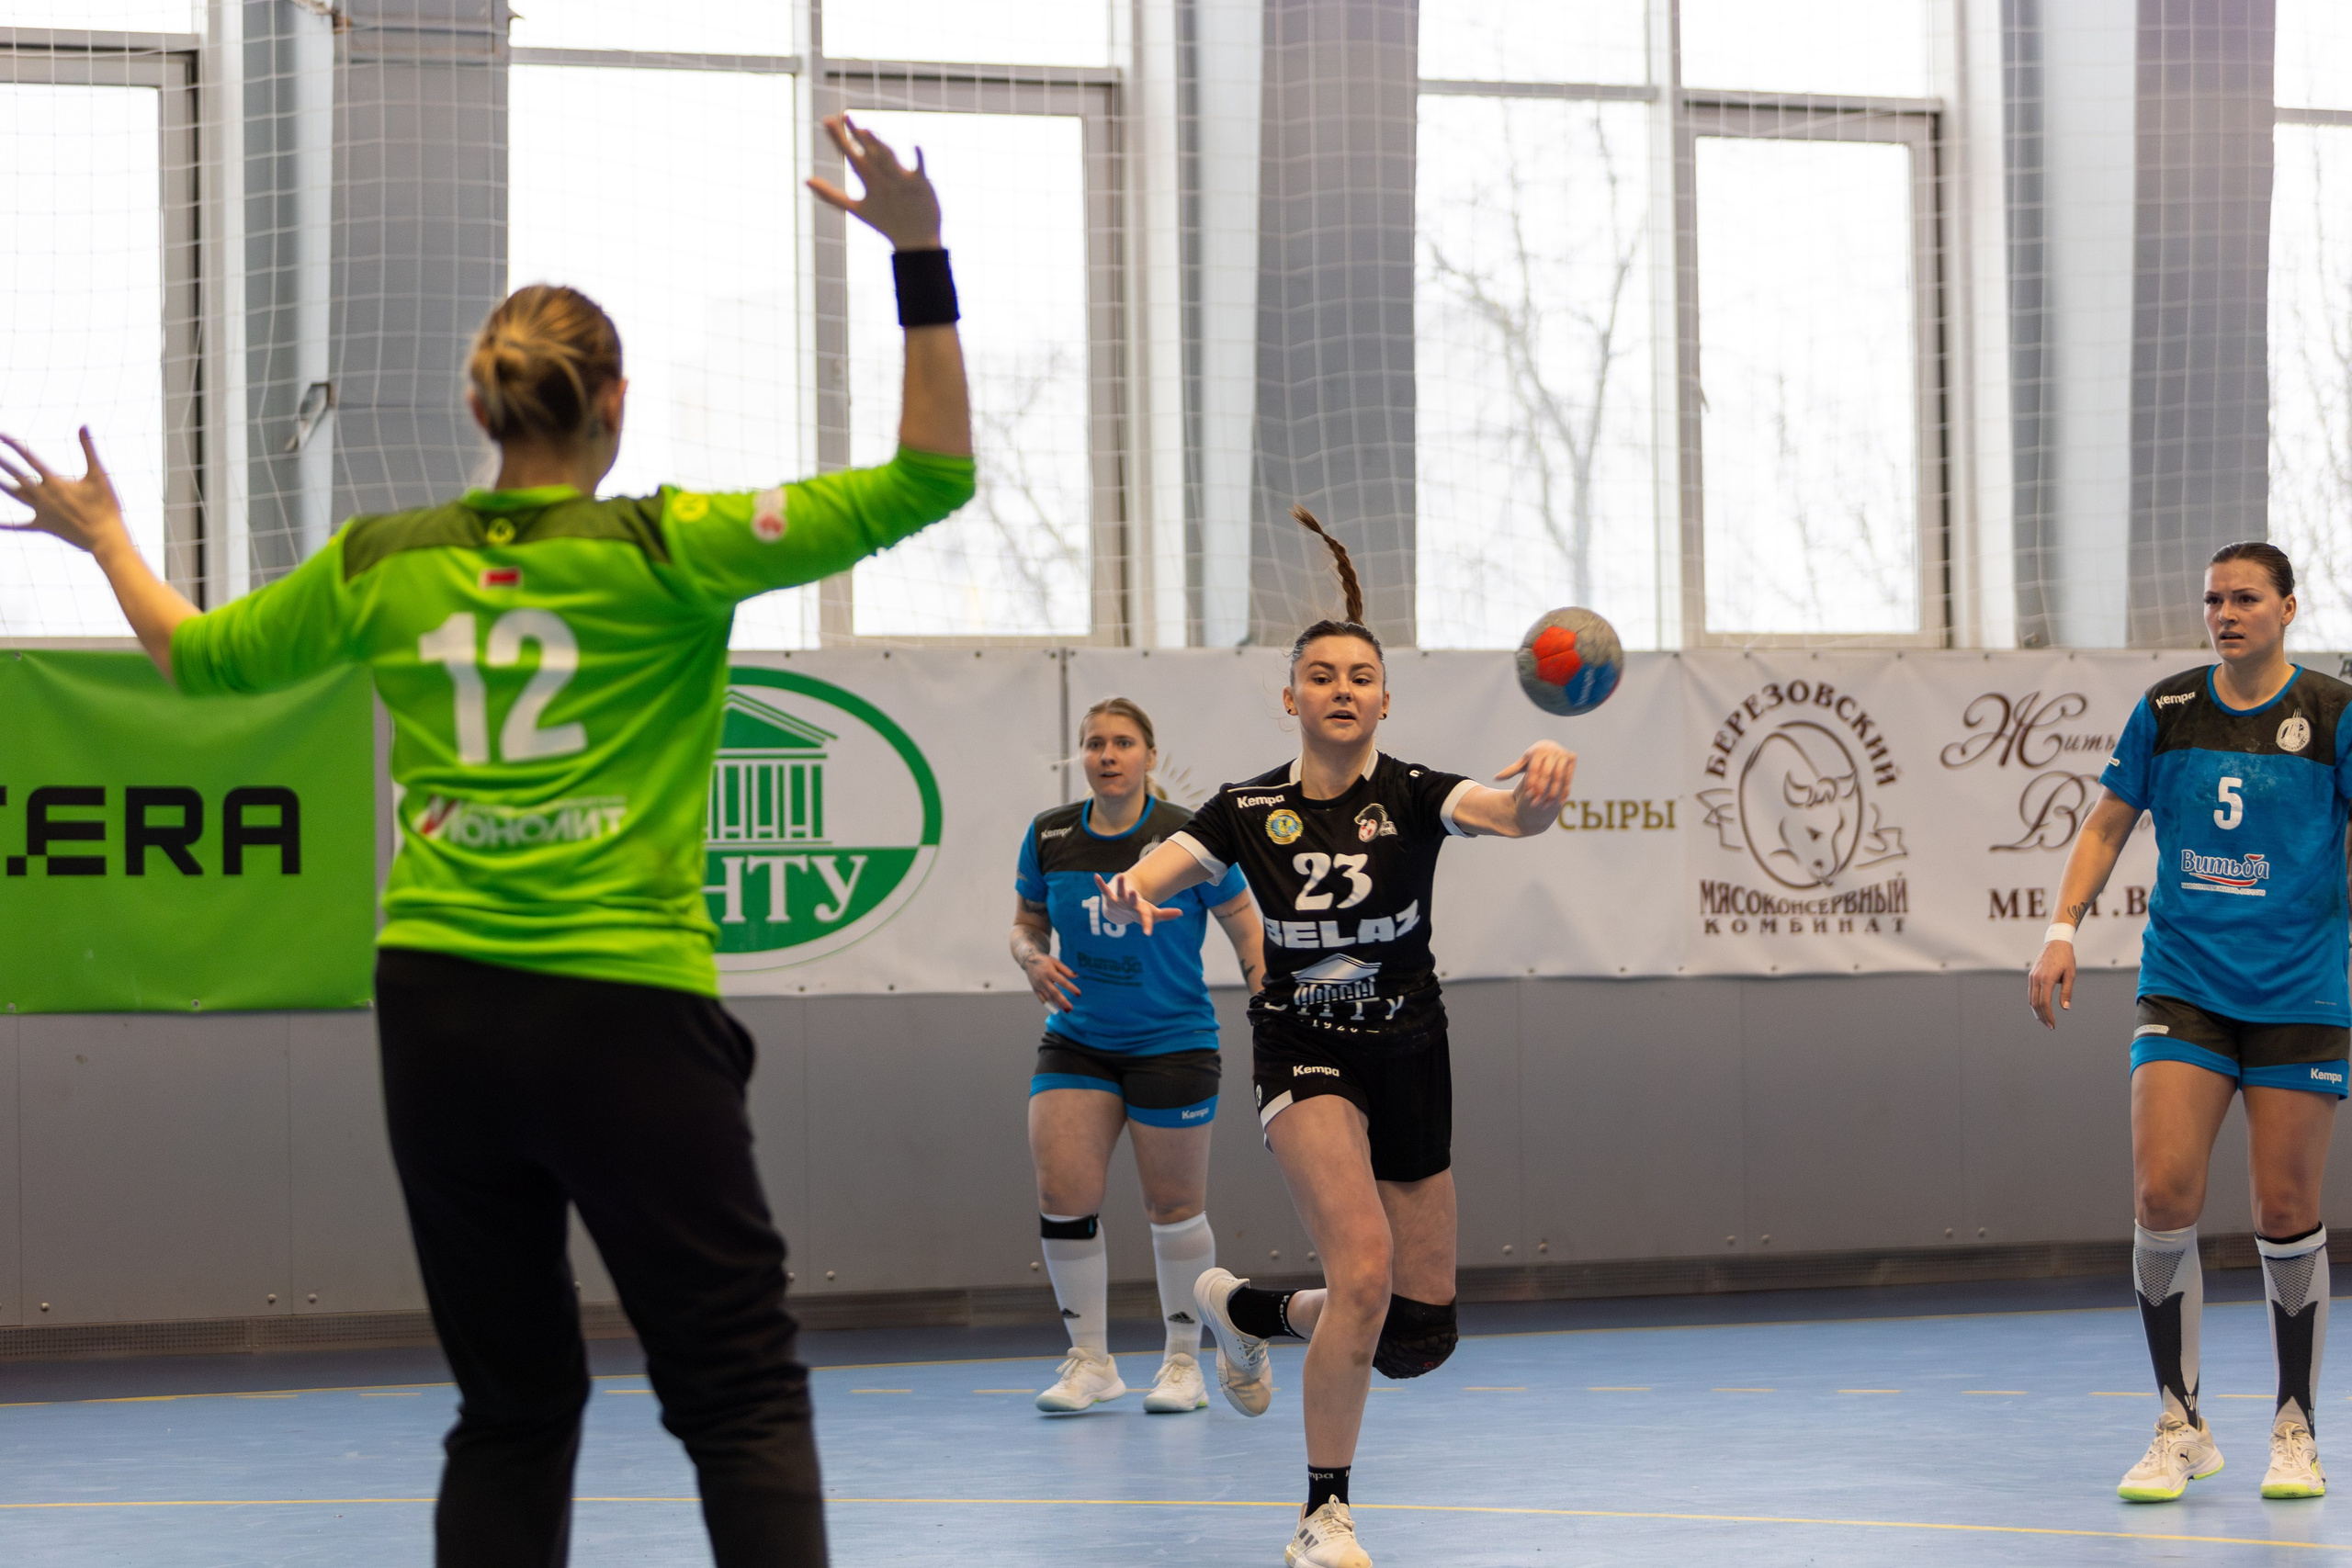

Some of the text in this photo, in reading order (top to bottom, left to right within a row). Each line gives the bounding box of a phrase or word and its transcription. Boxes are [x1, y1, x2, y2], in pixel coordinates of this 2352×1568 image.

[418, 608, 588, 766] 12
[2155, 691, 2196, 709] Kempa
[1704, 680, 1902, 787] БЕРЕЗОВСКИЙ
[1237, 795, 1285, 808] Kempa
[1557, 799, 1677, 830] СЫРЫ
[2213, 776, 2244, 830] 5
[0, 785, 300, 876] ERA
[2180, 849, 2270, 879] Витьба
[1293, 852, 1373, 910] 23
[1704, 919, 1905, 934] КОМБИНАТ
[1293, 1065, 1340, 1077] Kempa
[2310, 1067, 2343, 1084] Kempa
[1182, 1107, 1209, 1120] Kempa
